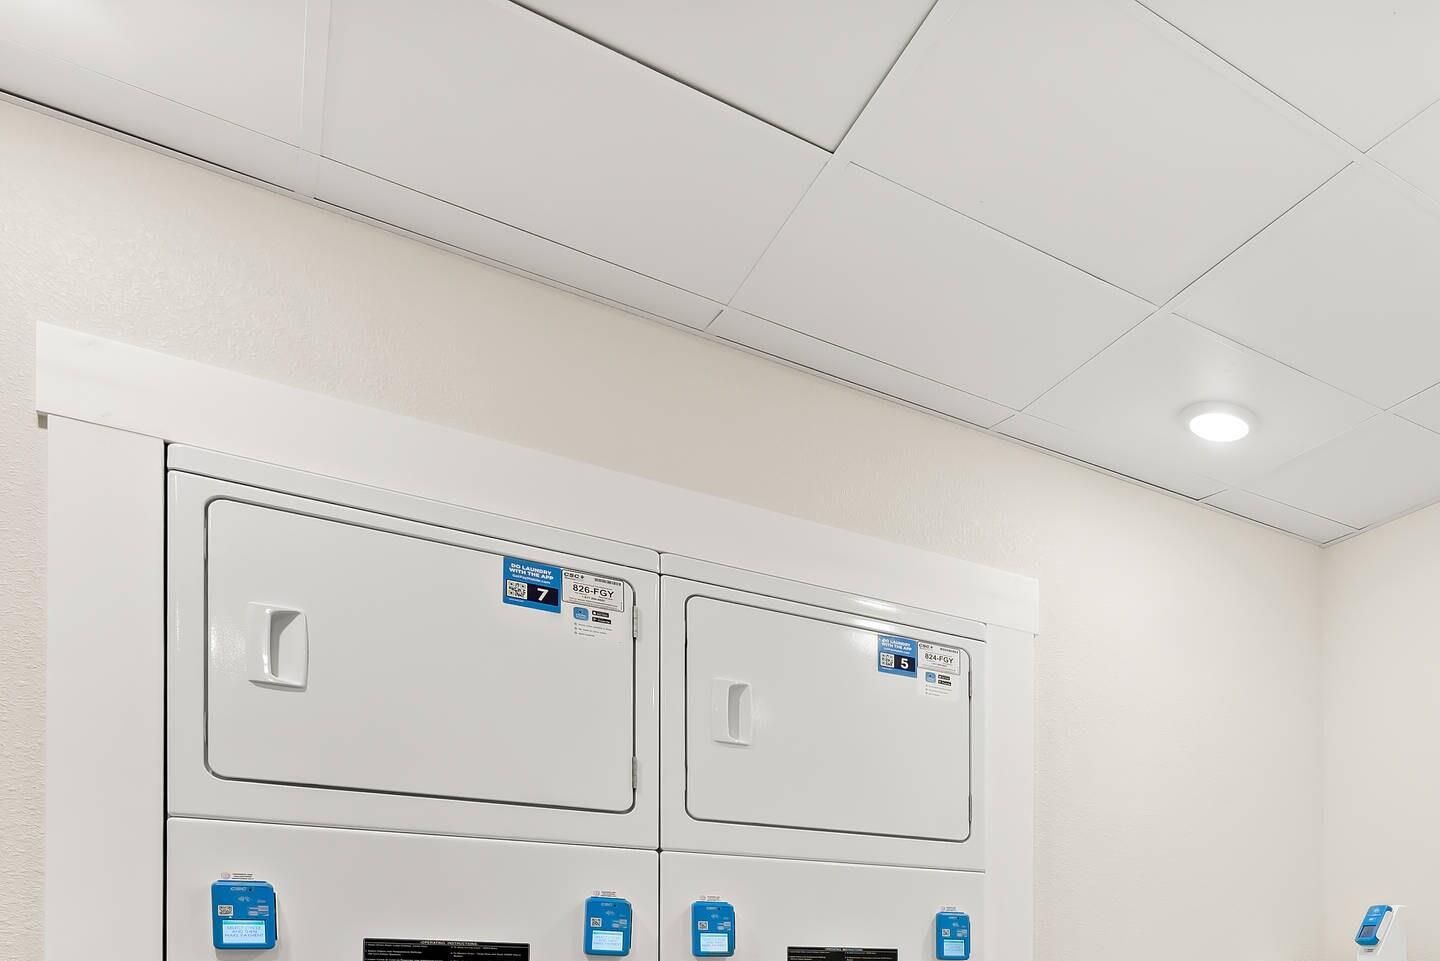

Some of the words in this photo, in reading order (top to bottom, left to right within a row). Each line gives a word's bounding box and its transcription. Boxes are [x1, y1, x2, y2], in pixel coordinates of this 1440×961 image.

[522, 565, 552, 576] LAUNDRY
[537, 588, 549, 601] 7
[572, 584, 614, 598] 826-FGY
[900, 658, 908, 669] 5
[924, 653, 954, 664] 824-FGY
